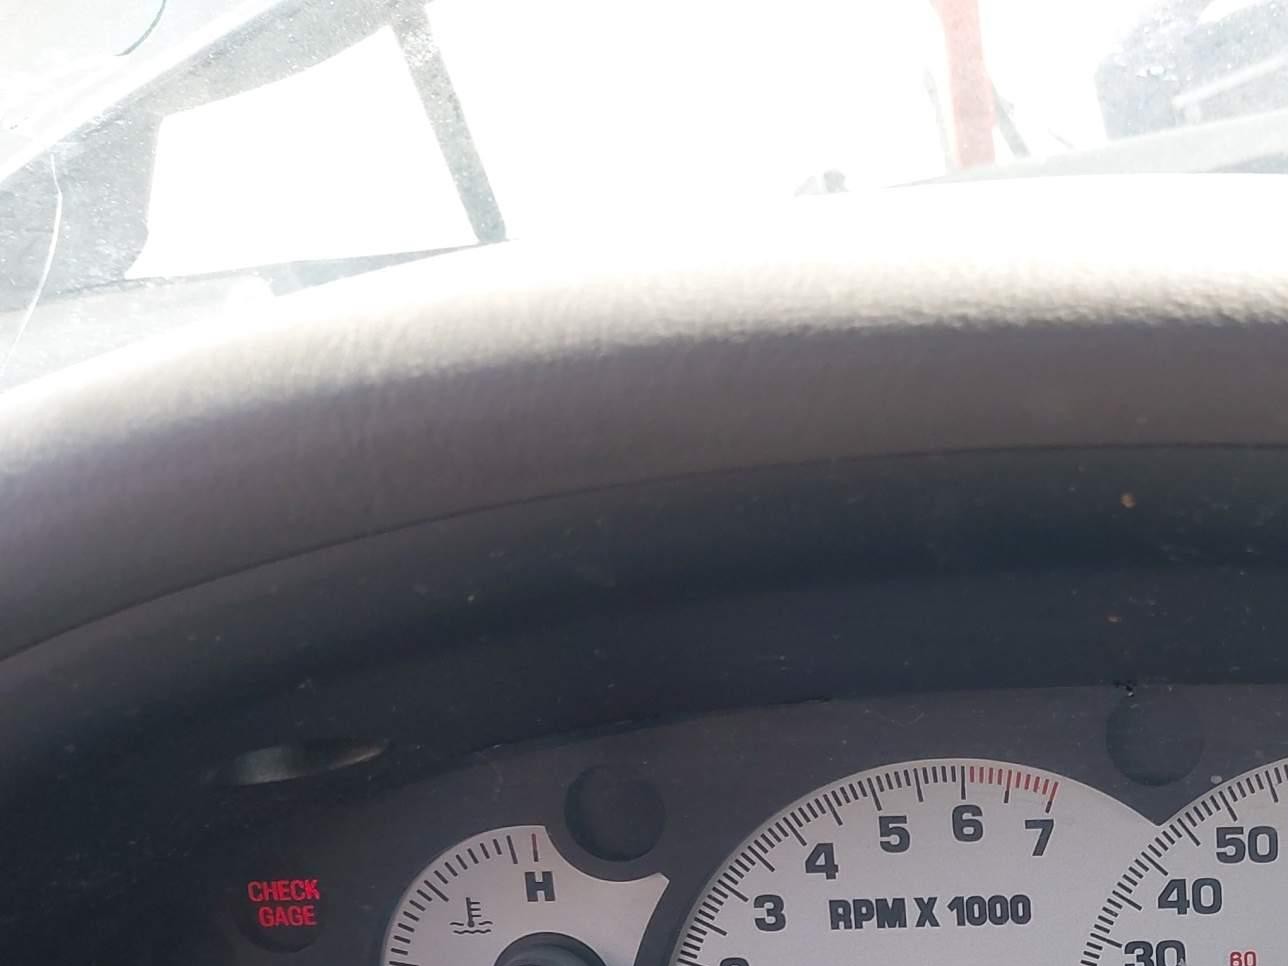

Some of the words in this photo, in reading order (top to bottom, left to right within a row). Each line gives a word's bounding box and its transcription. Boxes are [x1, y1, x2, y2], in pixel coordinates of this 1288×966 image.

[878, 815, 911, 853] 5
[951, 804, 984, 843] 6
[1024, 818, 1055, 857] 7
[804, 842, 839, 880] 4
[1215, 825, 1279, 864] 50
[248, 880, 321, 901] CHECK
[524, 870, 556, 903] H
[1157, 877, 1223, 915] 40
[258, 905, 317, 927] GAGE
[753, 894, 786, 932] 3
[828, 897, 908, 931] RPM
[913, 896, 940, 928] X
[947, 894, 1032, 927] 1000
